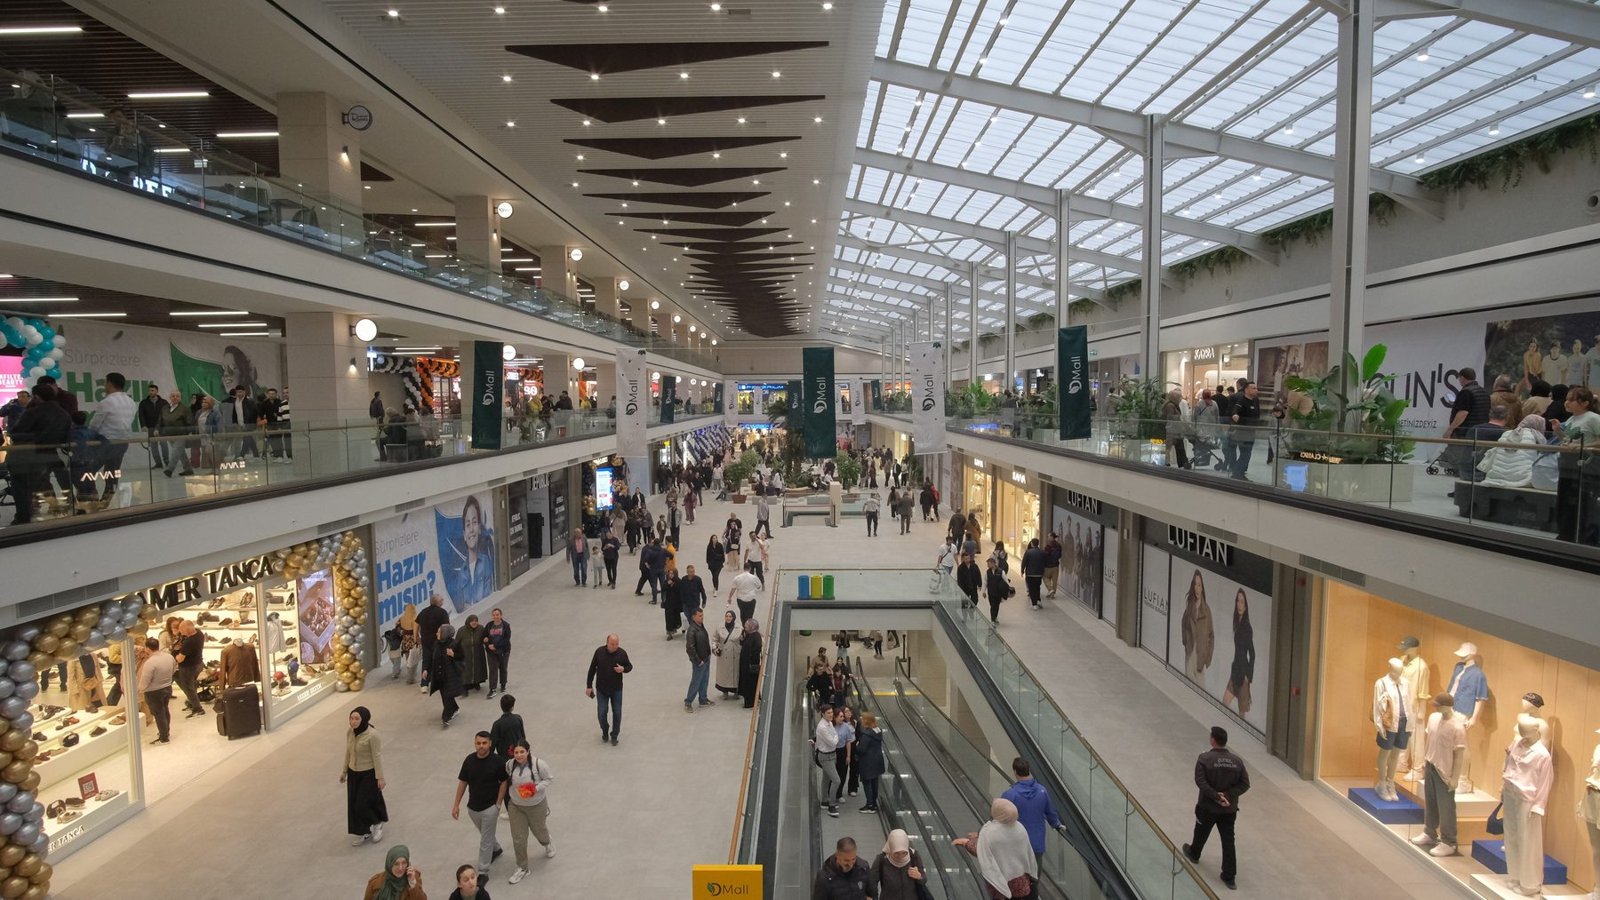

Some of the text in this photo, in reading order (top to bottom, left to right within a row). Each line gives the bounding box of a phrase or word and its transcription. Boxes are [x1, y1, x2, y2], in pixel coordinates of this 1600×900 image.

[1067, 490, 1099, 515] LUFIAN
[1168, 524, 1228, 567] LUFIAN
[203, 555, 274, 595] TANCA
[376, 551, 427, 593] Hazır
